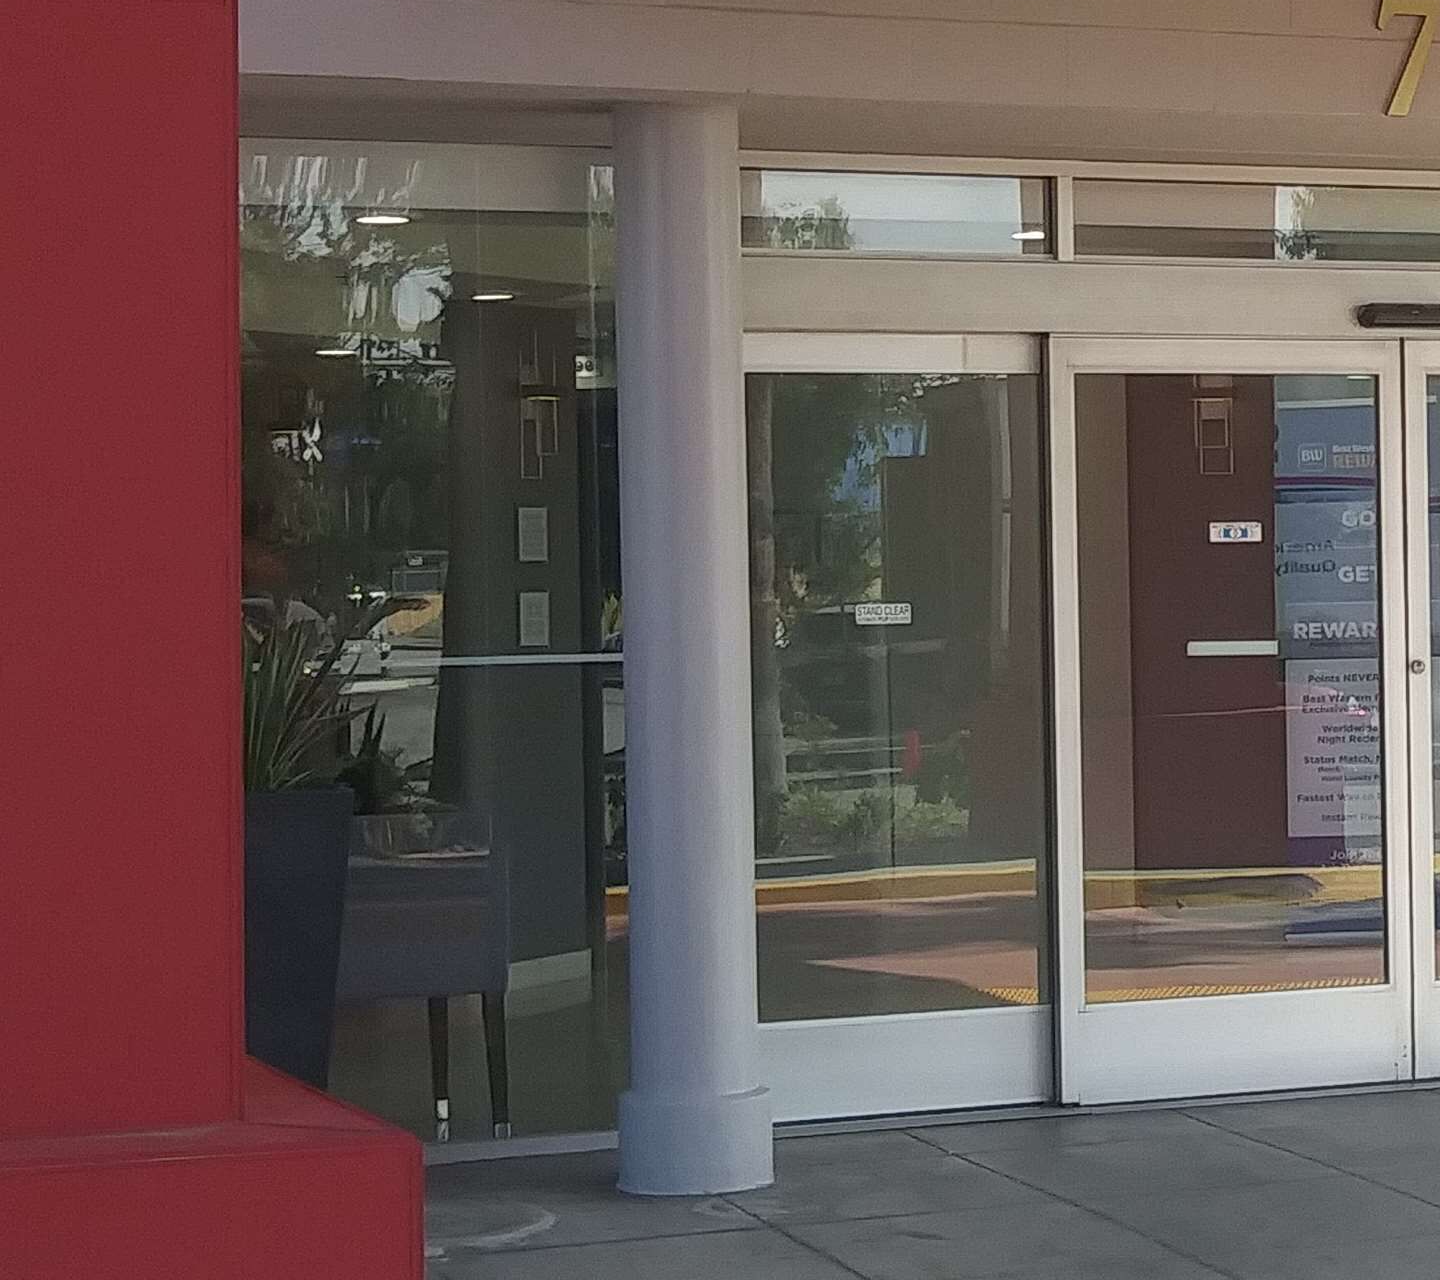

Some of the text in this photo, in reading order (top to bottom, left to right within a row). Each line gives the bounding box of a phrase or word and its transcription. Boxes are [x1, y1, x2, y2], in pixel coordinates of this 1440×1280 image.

[1301, 449, 1324, 463] BW
[1308, 674, 1340, 683] Points
[1317, 735, 1346, 745] Night
[1303, 756, 1336, 765] Status
